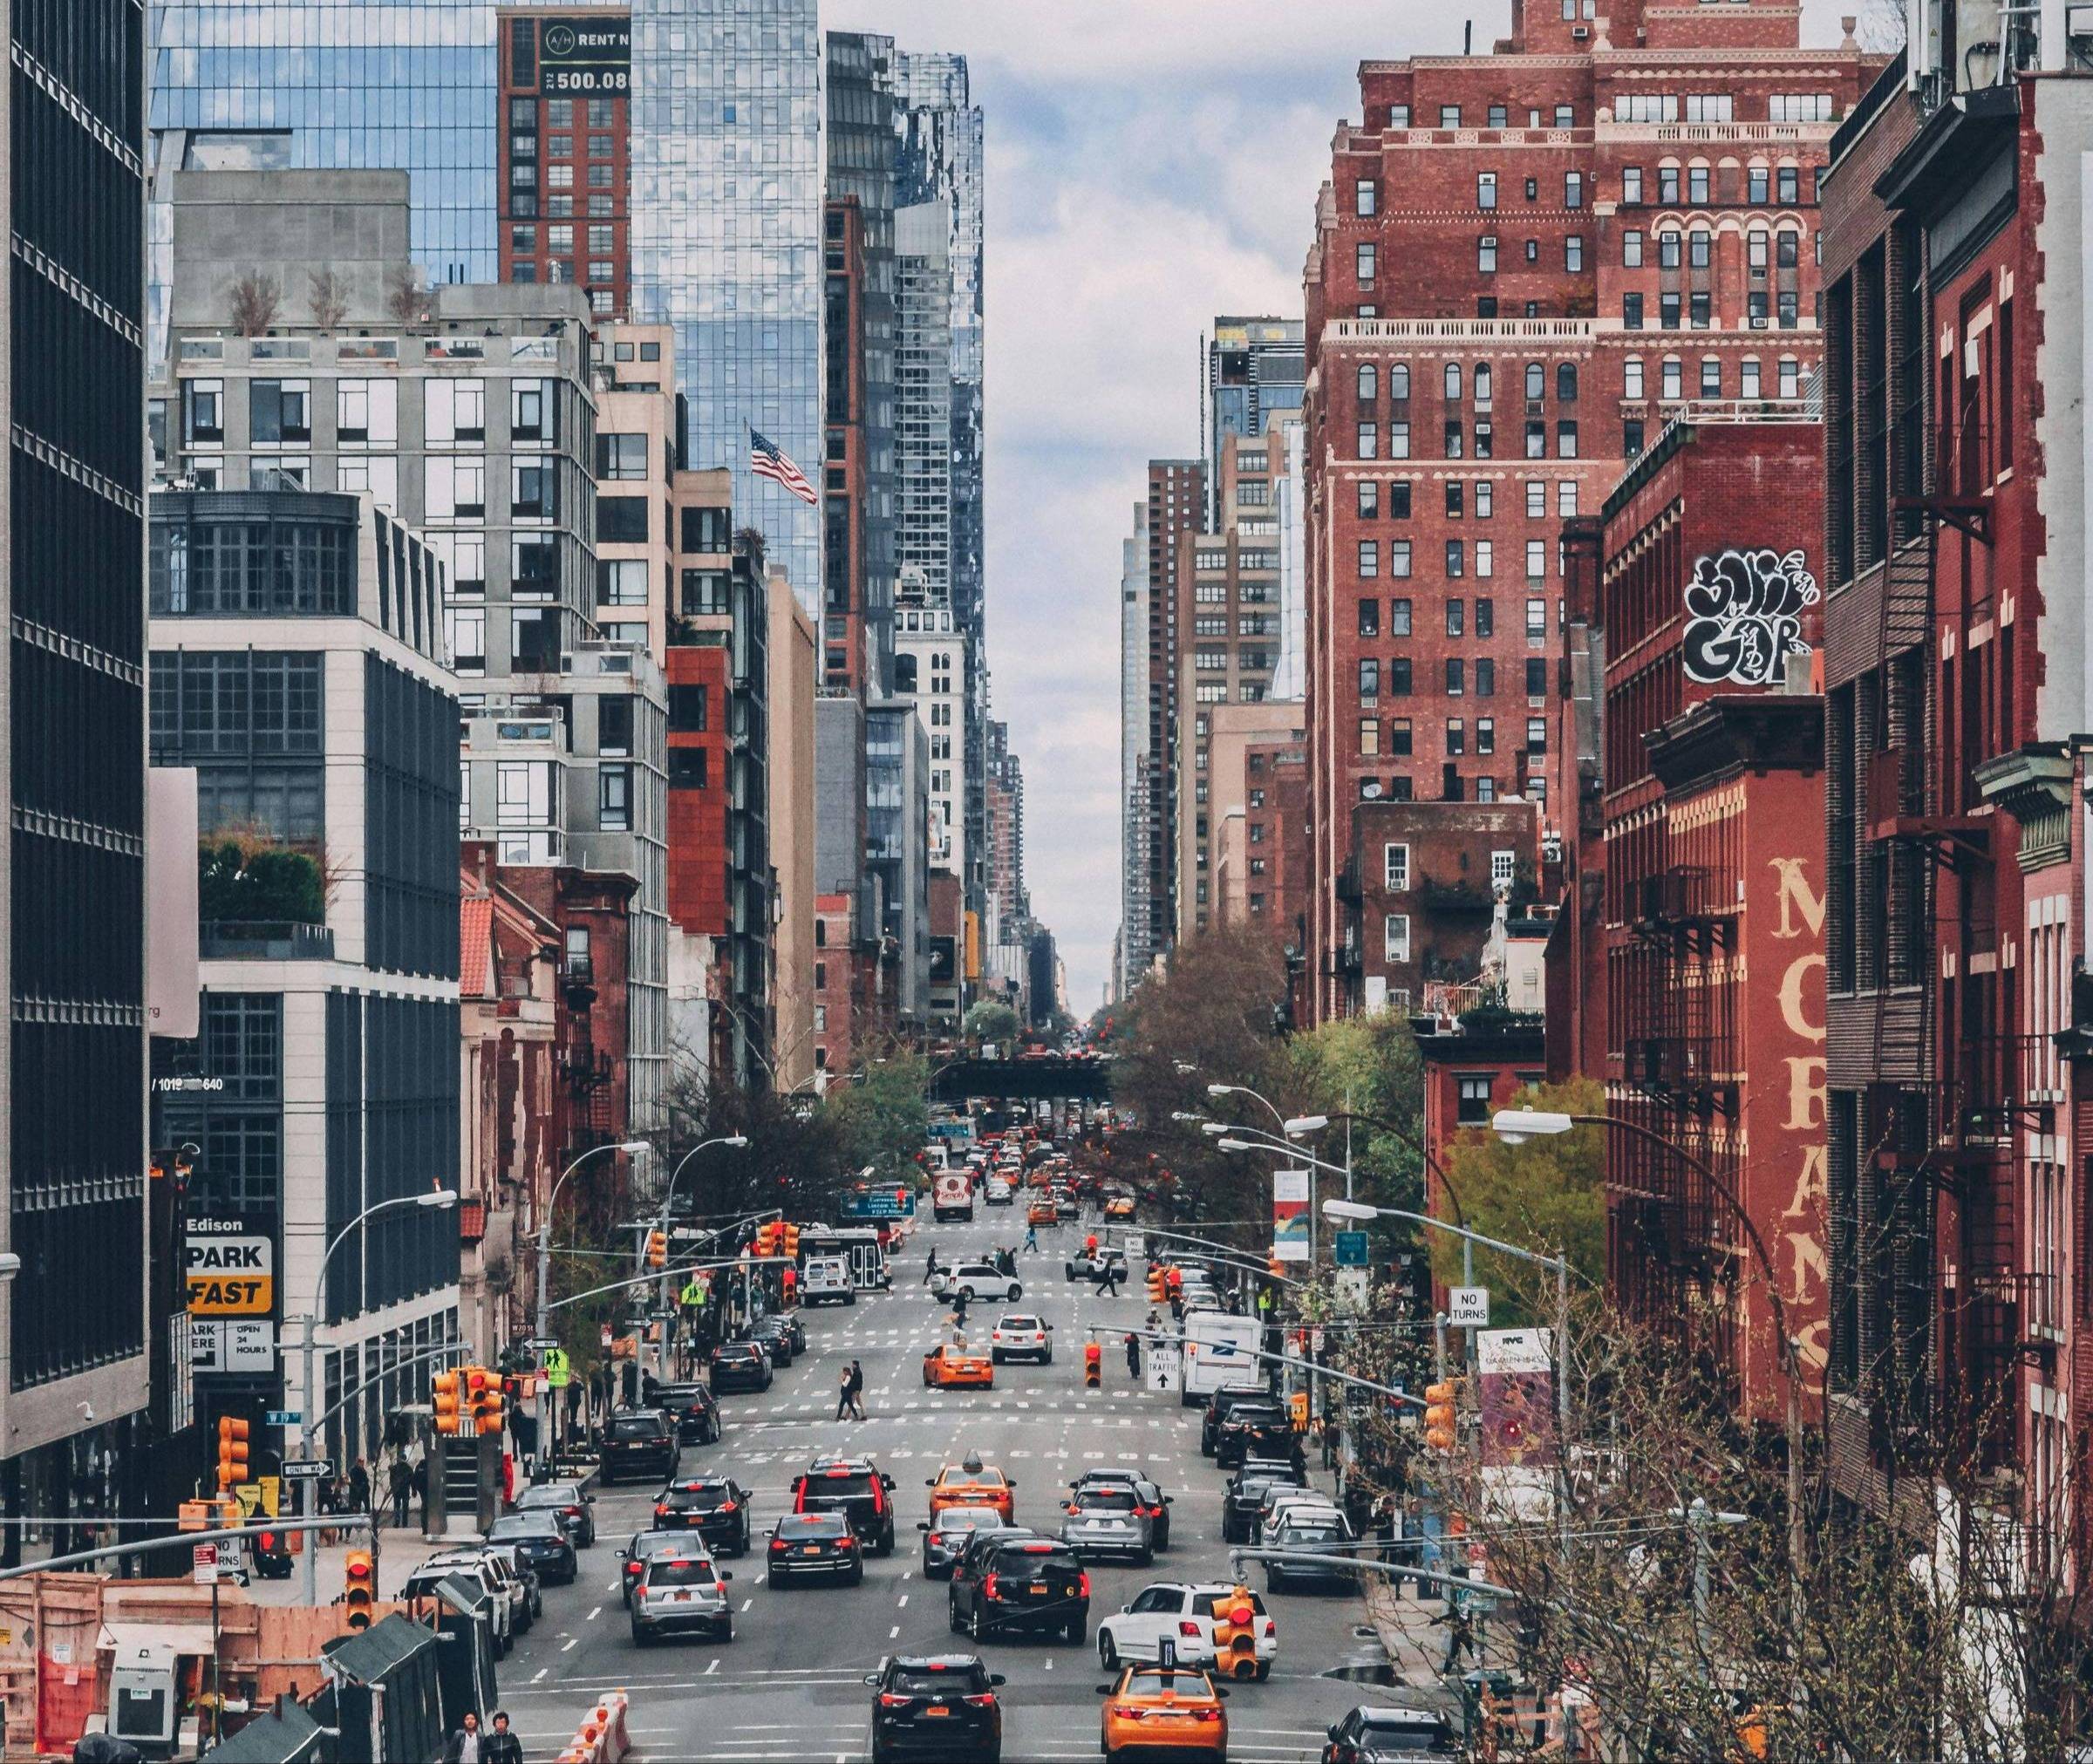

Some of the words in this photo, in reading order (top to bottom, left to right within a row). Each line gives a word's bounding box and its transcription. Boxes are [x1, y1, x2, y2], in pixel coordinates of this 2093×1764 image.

[578, 33, 617, 46] RENT
[546, 72, 555, 90] 212
[557, 72, 631, 89] 500.08
[187, 1218, 242, 1232] Edison
[187, 1245, 262, 1269] PARK
[187, 1281, 262, 1306] FAST
[1461, 1294, 1477, 1305] NO
[1453, 1309, 1486, 1320] TURNS
[191, 1325, 216, 1336] ARK
[191, 1338, 216, 1349] ERE
[236, 1345, 267, 1354] HOURS
[1156, 1352, 1171, 1361] ALL
[1149, 1363, 1178, 1372] TRAFFIC
[310, 1464, 327, 1474] WAY
[218, 1555, 240, 1566] RNS
